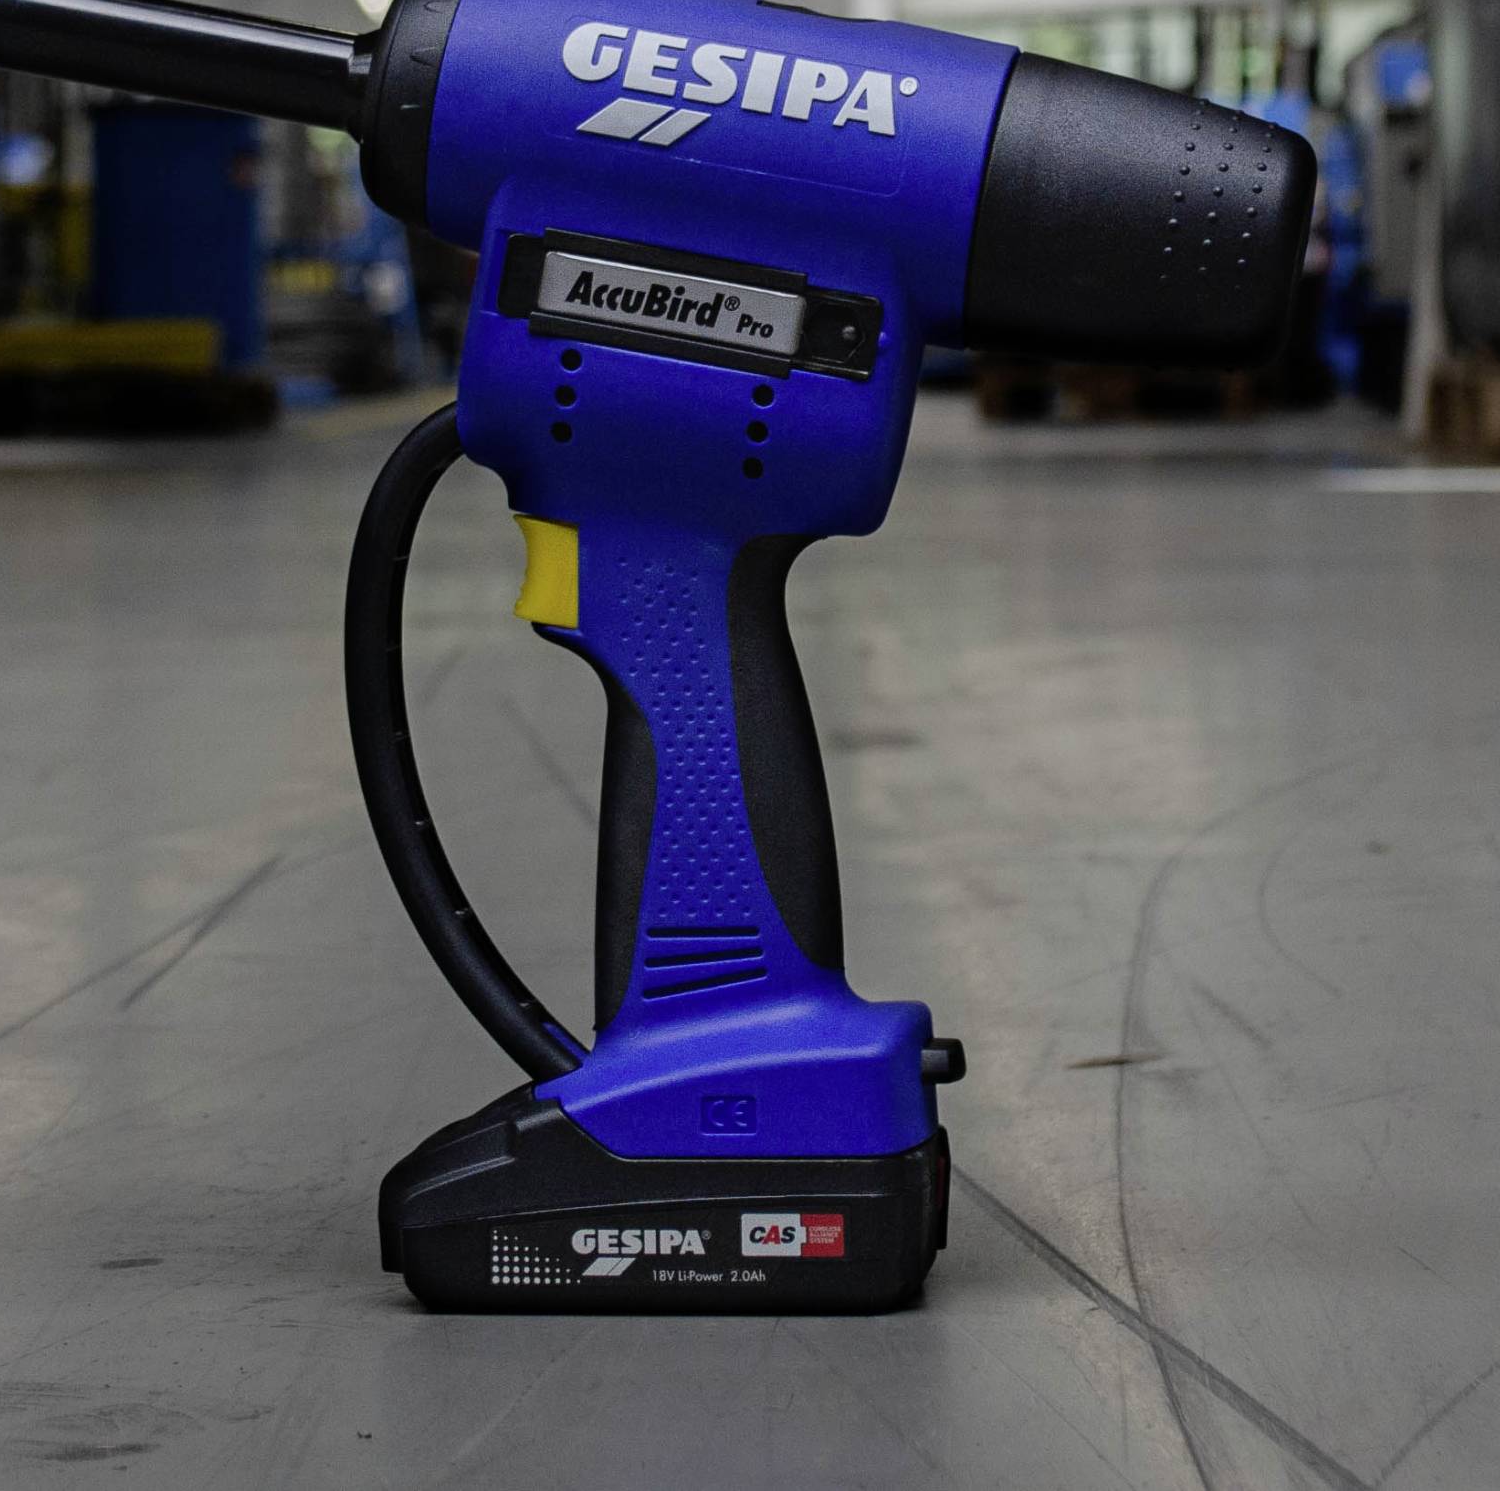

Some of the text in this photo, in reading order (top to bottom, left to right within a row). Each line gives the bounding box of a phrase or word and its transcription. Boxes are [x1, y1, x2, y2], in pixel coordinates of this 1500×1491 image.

[736, 313, 774, 339] Pro
[749, 1225, 796, 1245] CAS
[652, 1269, 766, 1283] 18V Li-Power 2.0Ah
